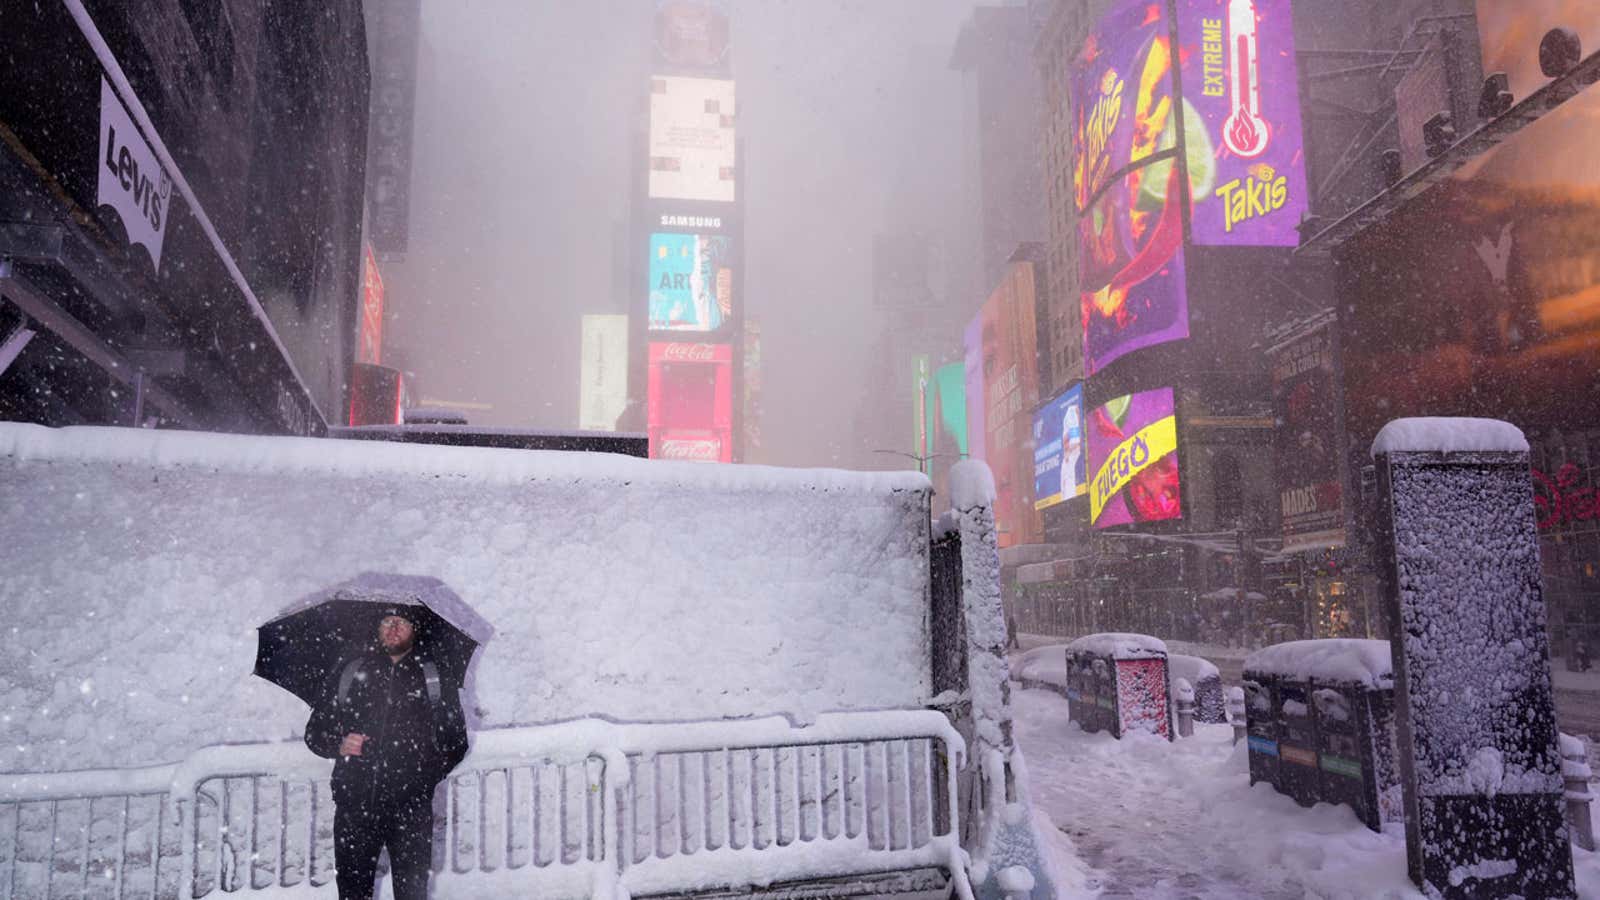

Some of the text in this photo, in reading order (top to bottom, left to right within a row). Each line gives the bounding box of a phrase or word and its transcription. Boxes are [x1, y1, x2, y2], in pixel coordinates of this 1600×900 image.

[1202, 18, 1225, 97] EXTREME
[1086, 79, 1124, 187] Takis
[660, 215, 722, 229] SAMSUNG
[1216, 174, 1288, 233] Takis
[1097, 434, 1150, 507] FUEGO
